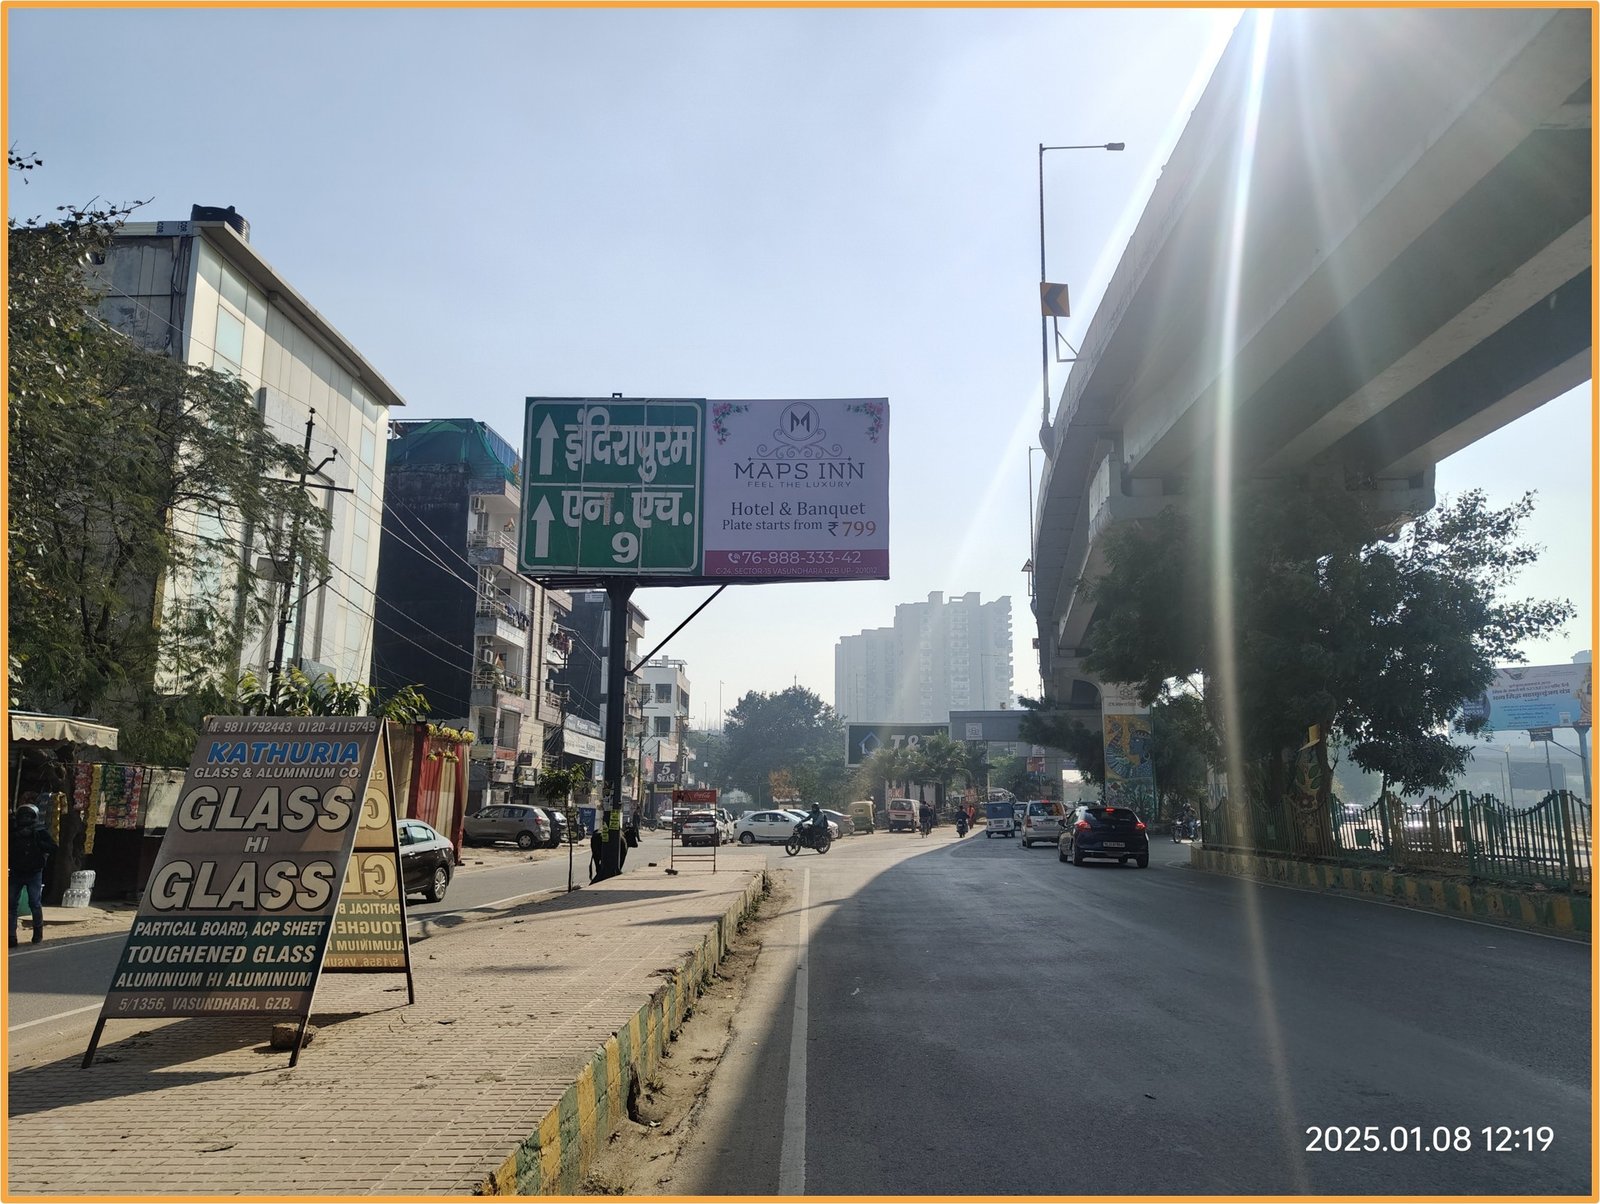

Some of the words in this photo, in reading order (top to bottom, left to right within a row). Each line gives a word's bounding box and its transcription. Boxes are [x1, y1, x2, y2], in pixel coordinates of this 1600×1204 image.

[564, 406, 695, 482] इंदिरापुरम
[734, 462, 809, 480] MAPS
[818, 462, 865, 480] INN
[561, 491, 624, 528] एन.
[631, 492, 693, 529] एच.
[731, 502, 774, 516] Hotel
[779, 502, 792, 516] &
[797, 502, 866, 518] Banquet
[722, 519, 753, 530] Plate
[756, 519, 790, 530] starts
[794, 519, 823, 530] from
[842, 520, 877, 537] 799
[611, 531, 639, 563] 9
[742, 551, 861, 564] 76-888-333-42
[773, 566, 823, 575] VASUNDHARA
[207, 722, 220, 733] M:
[298, 721, 377, 733] 0120-4115749
[207, 741, 361, 765] KATHURIA
[194, 767, 239, 778] GLASS
[243, 767, 253, 778] &
[256, 767, 335, 778] ALUMINIUM
[339, 767, 362, 778] CO.
[662, 763, 671, 775] 5
[178, 785, 355, 832] GLASS
[150, 860, 337, 911] GLASS
[134, 921, 197, 936] PARTICAL
[201, 921, 248, 939] BOARD,
[251, 921, 279, 936] ACP
[282, 921, 326, 936] SHEET
[127, 946, 247, 963] TOUGHENED
[252, 945, 316, 963] GLASS
[115, 972, 202, 988] ALUMINIUM
[206, 972, 223, 987] HI
[225, 972, 313, 987] ALUMINIUM
[118, 997, 167, 1012] 5/1356,
[172, 997, 260, 1010] VASUNDHARA.
[264, 997, 293, 1010] GZB.
